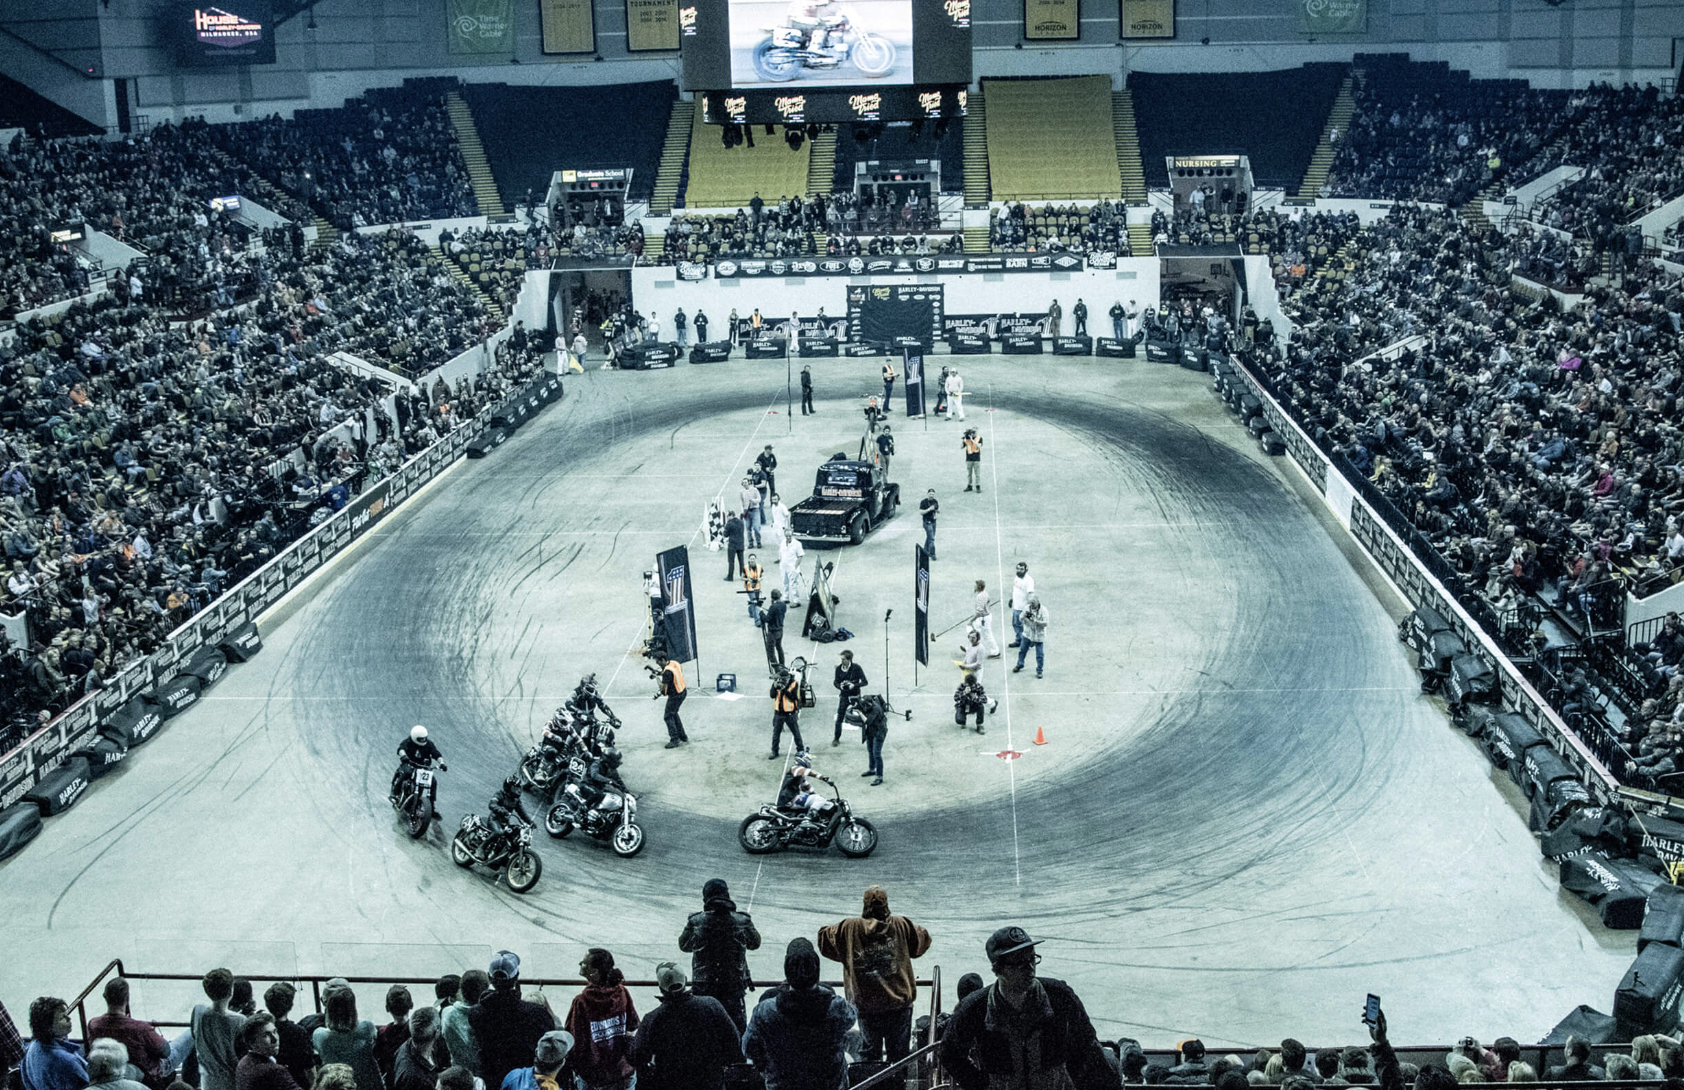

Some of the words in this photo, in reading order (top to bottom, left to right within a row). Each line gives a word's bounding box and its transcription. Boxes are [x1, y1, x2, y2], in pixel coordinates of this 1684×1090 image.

[480, 30, 502, 38] Cable
[604, 169, 624, 177] School
[59, 777, 82, 805] HARLEY-
